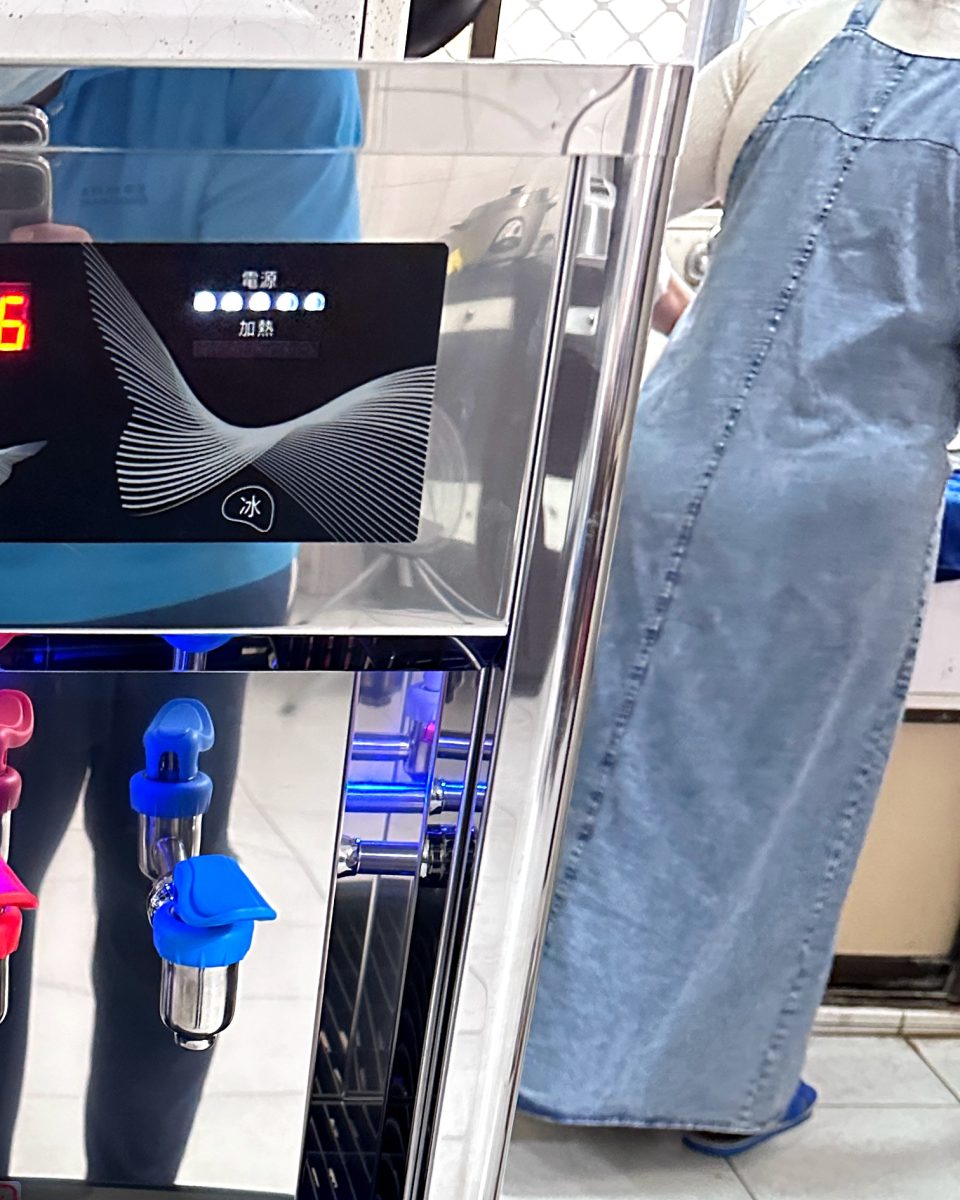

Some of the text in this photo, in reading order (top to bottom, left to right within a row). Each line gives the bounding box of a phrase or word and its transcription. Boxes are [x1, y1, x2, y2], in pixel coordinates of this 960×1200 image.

[241, 270, 278, 289] 電源
[238, 319, 275, 338] 加熱
[239, 496, 262, 519] 冰
